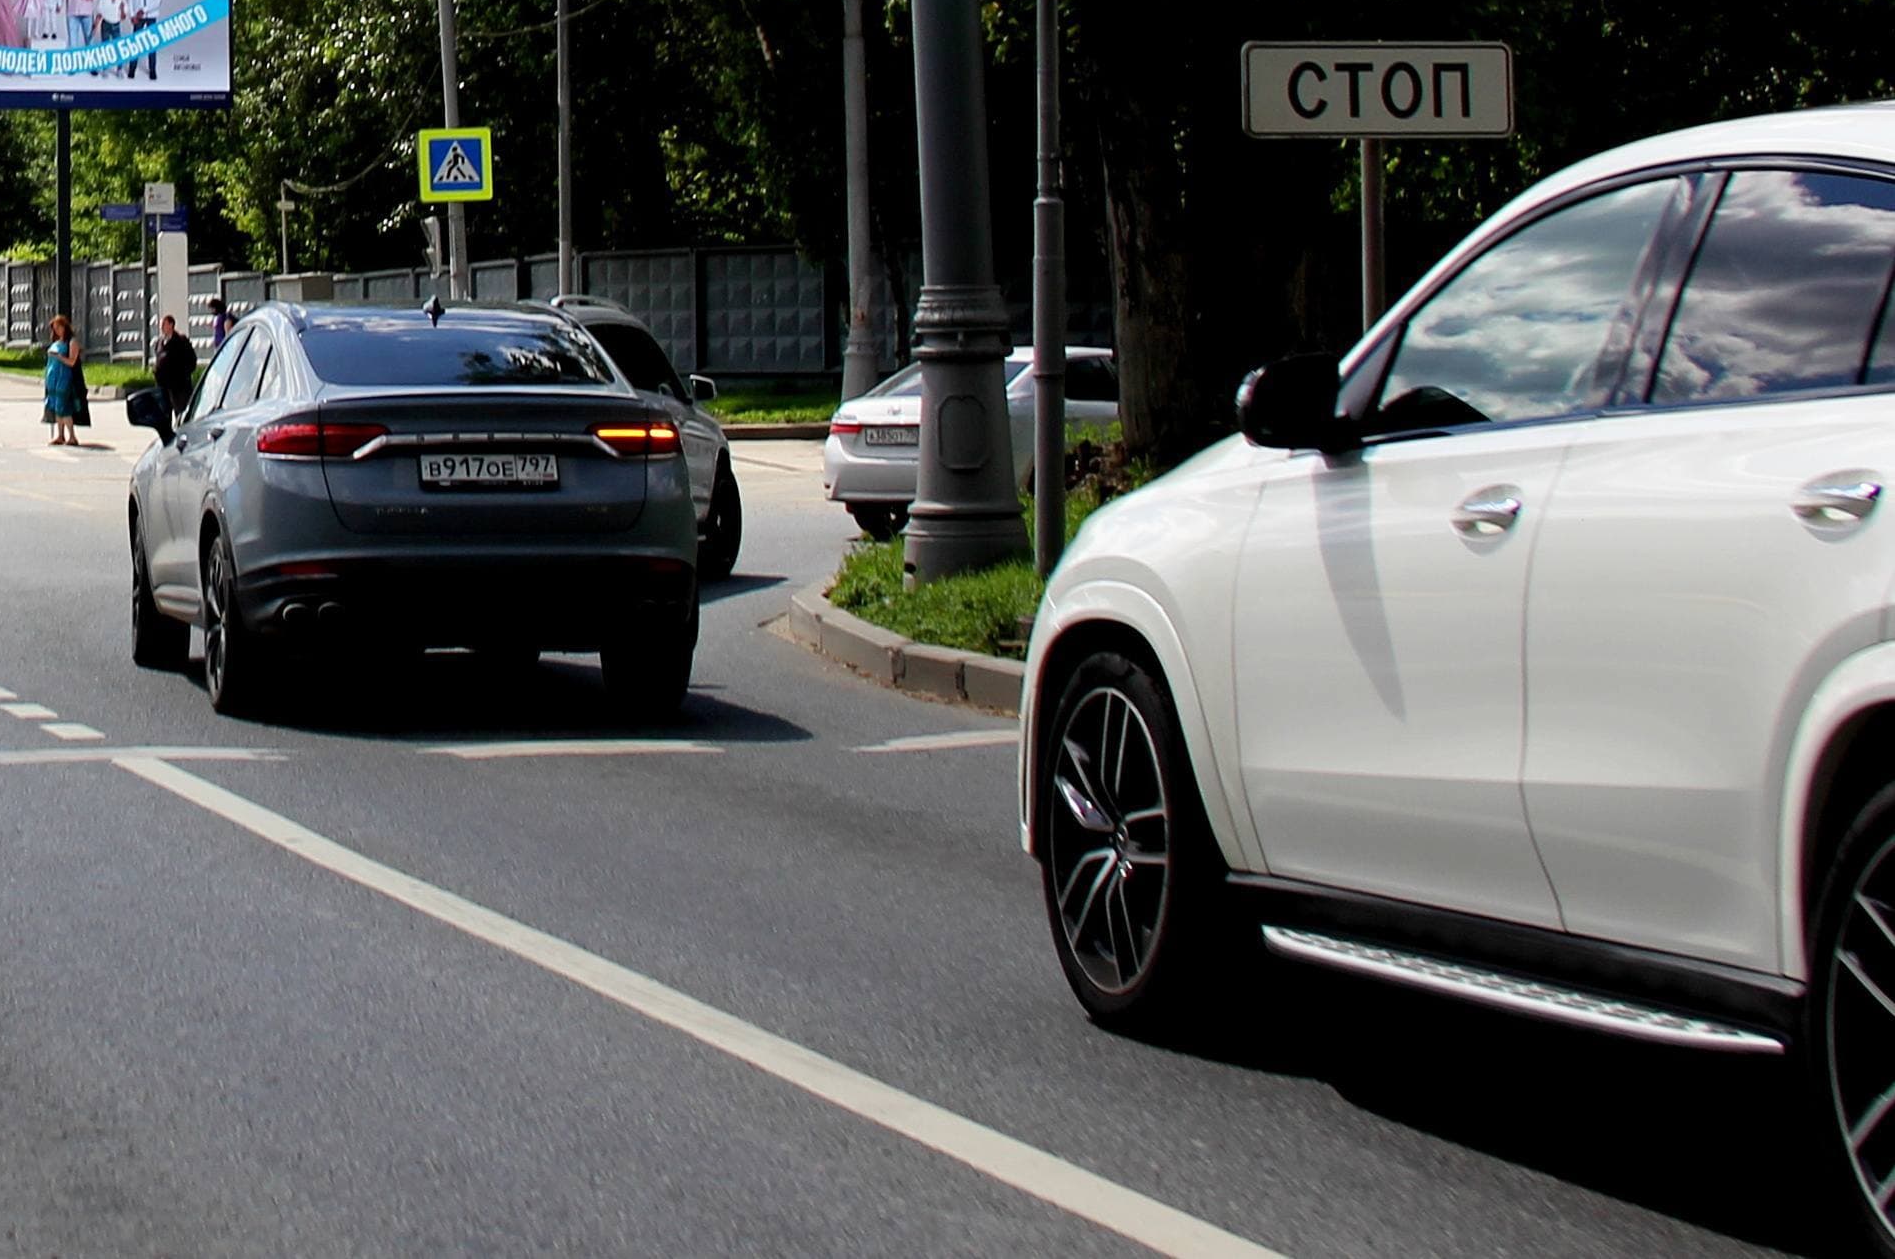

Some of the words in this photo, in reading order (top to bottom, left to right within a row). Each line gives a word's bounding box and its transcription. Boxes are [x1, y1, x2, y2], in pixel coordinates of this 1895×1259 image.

[50, 42, 117, 75] ДОЛЖНО
[120, 26, 161, 59] БЫТЬ
[157, 6, 208, 42] МНОГО
[1287, 60, 1471, 119] СТОП
[519, 456, 551, 472] 797
